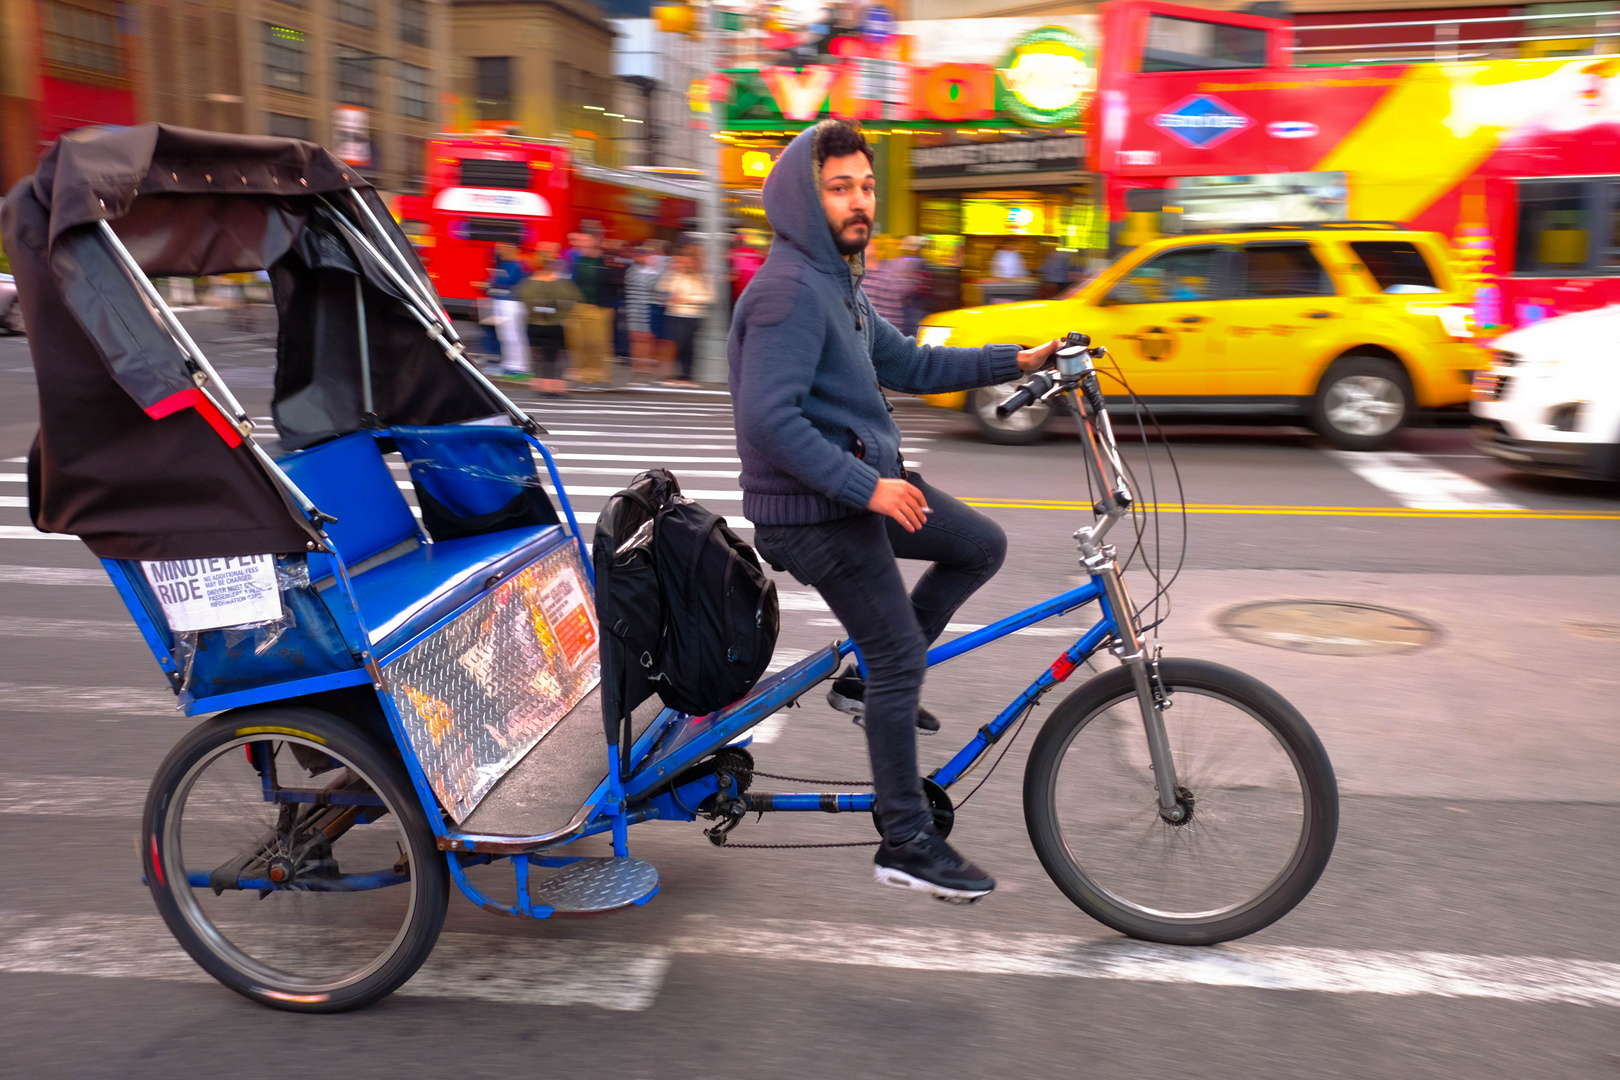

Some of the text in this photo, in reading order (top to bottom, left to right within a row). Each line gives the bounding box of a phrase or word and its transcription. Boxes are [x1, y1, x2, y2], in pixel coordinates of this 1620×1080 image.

[151, 557, 221, 582] MINUTE
[212, 570, 244, 581] ADDITIONAL
[245, 566, 259, 574] FEES
[226, 574, 254, 584] CHARGED.
[157, 579, 203, 605] RIDE
[207, 587, 226, 596] DRIVER
[227, 584, 242, 592] MUST
[210, 596, 246, 608] INFORMATION
